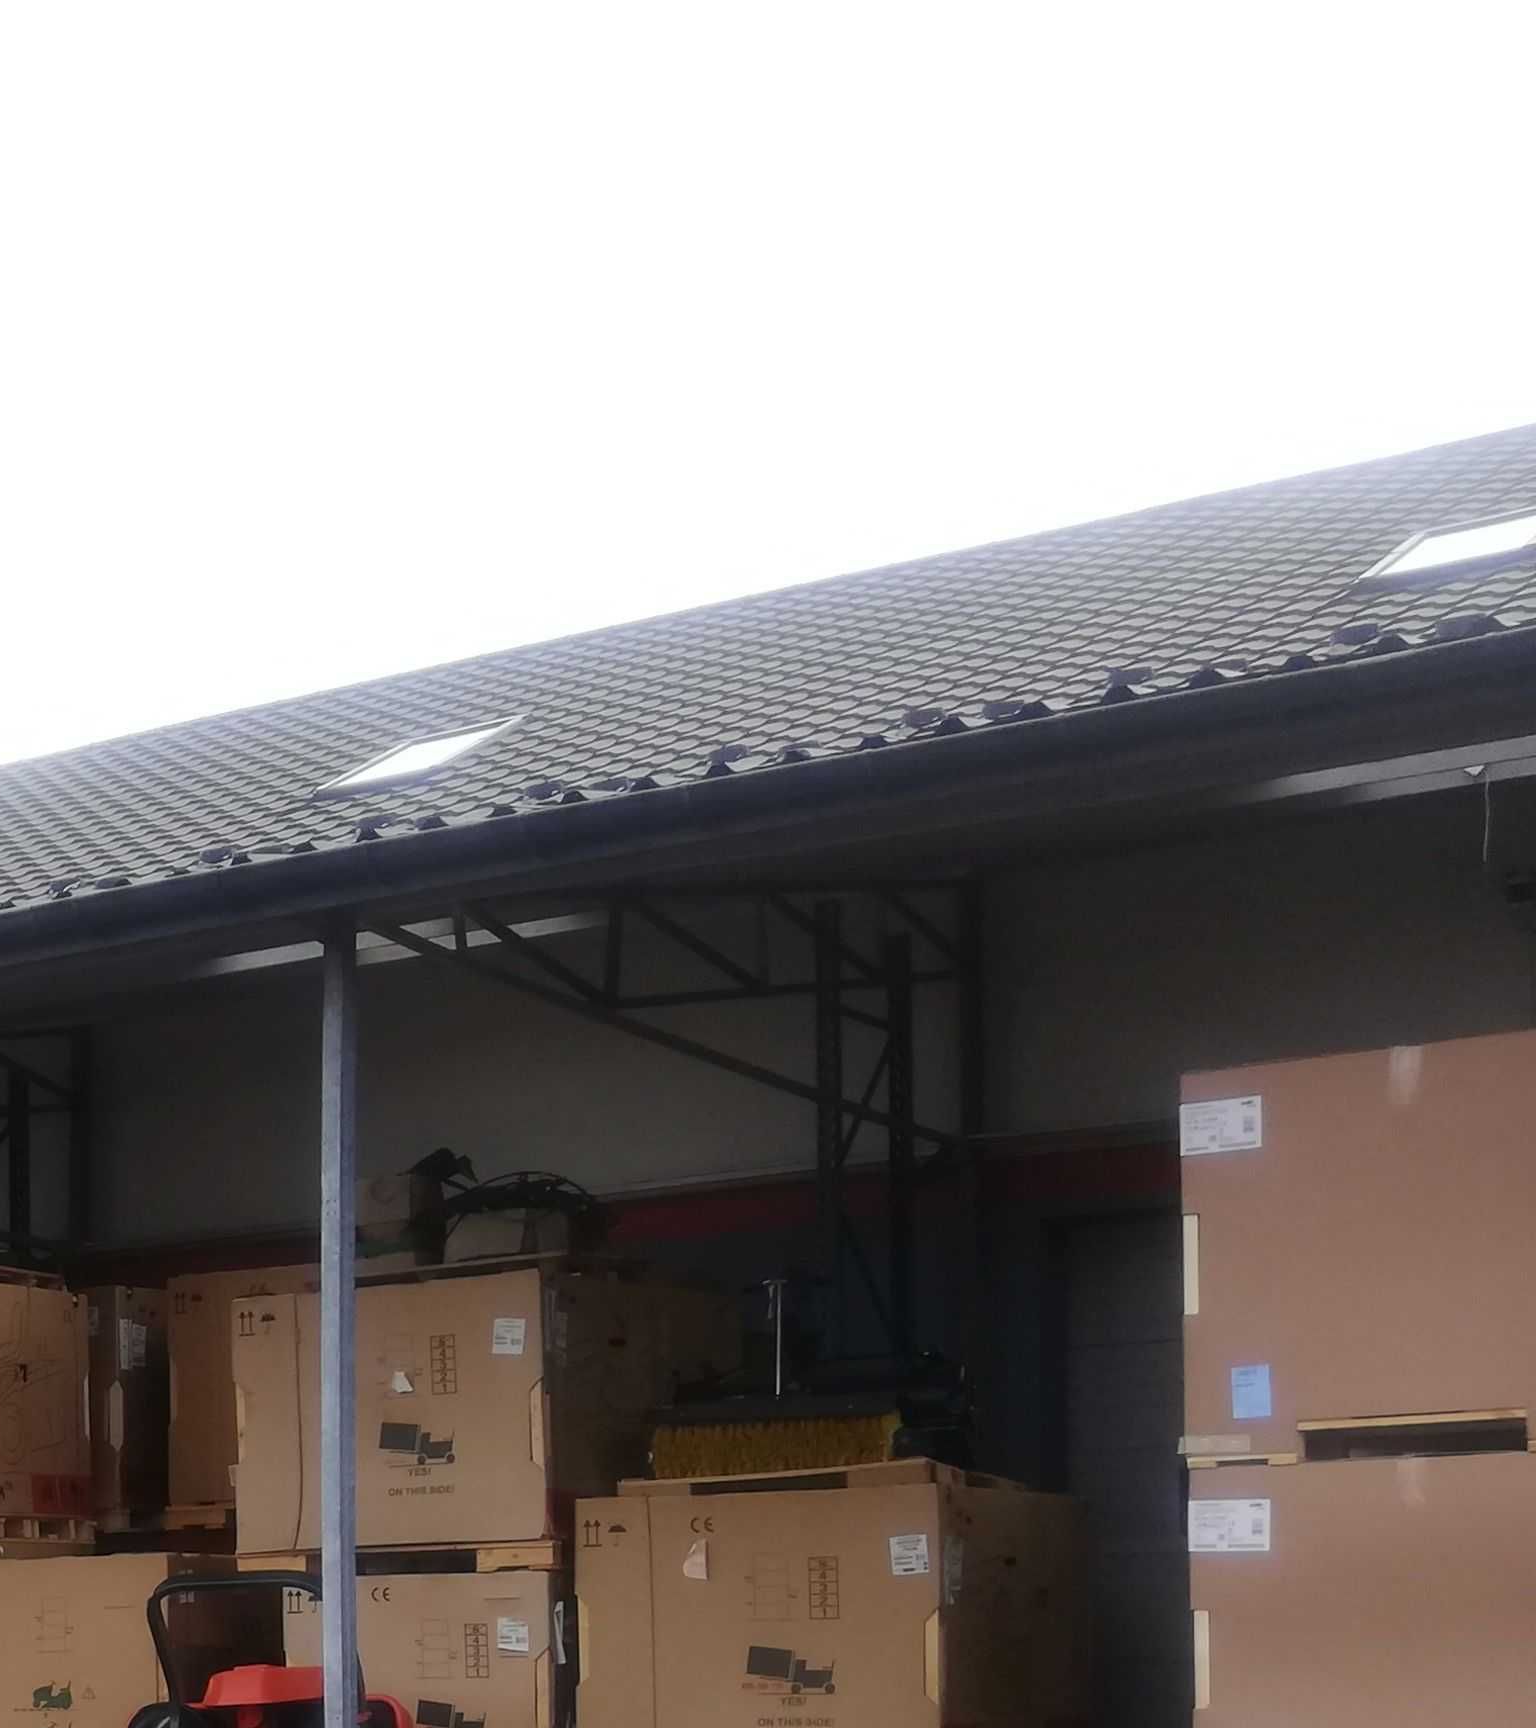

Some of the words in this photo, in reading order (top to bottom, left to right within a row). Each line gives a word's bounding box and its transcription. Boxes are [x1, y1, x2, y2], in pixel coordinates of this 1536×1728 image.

[690, 1516, 715, 1533] CE
[371, 1587, 391, 1602] CE
[758, 1717, 774, 1728] ON
